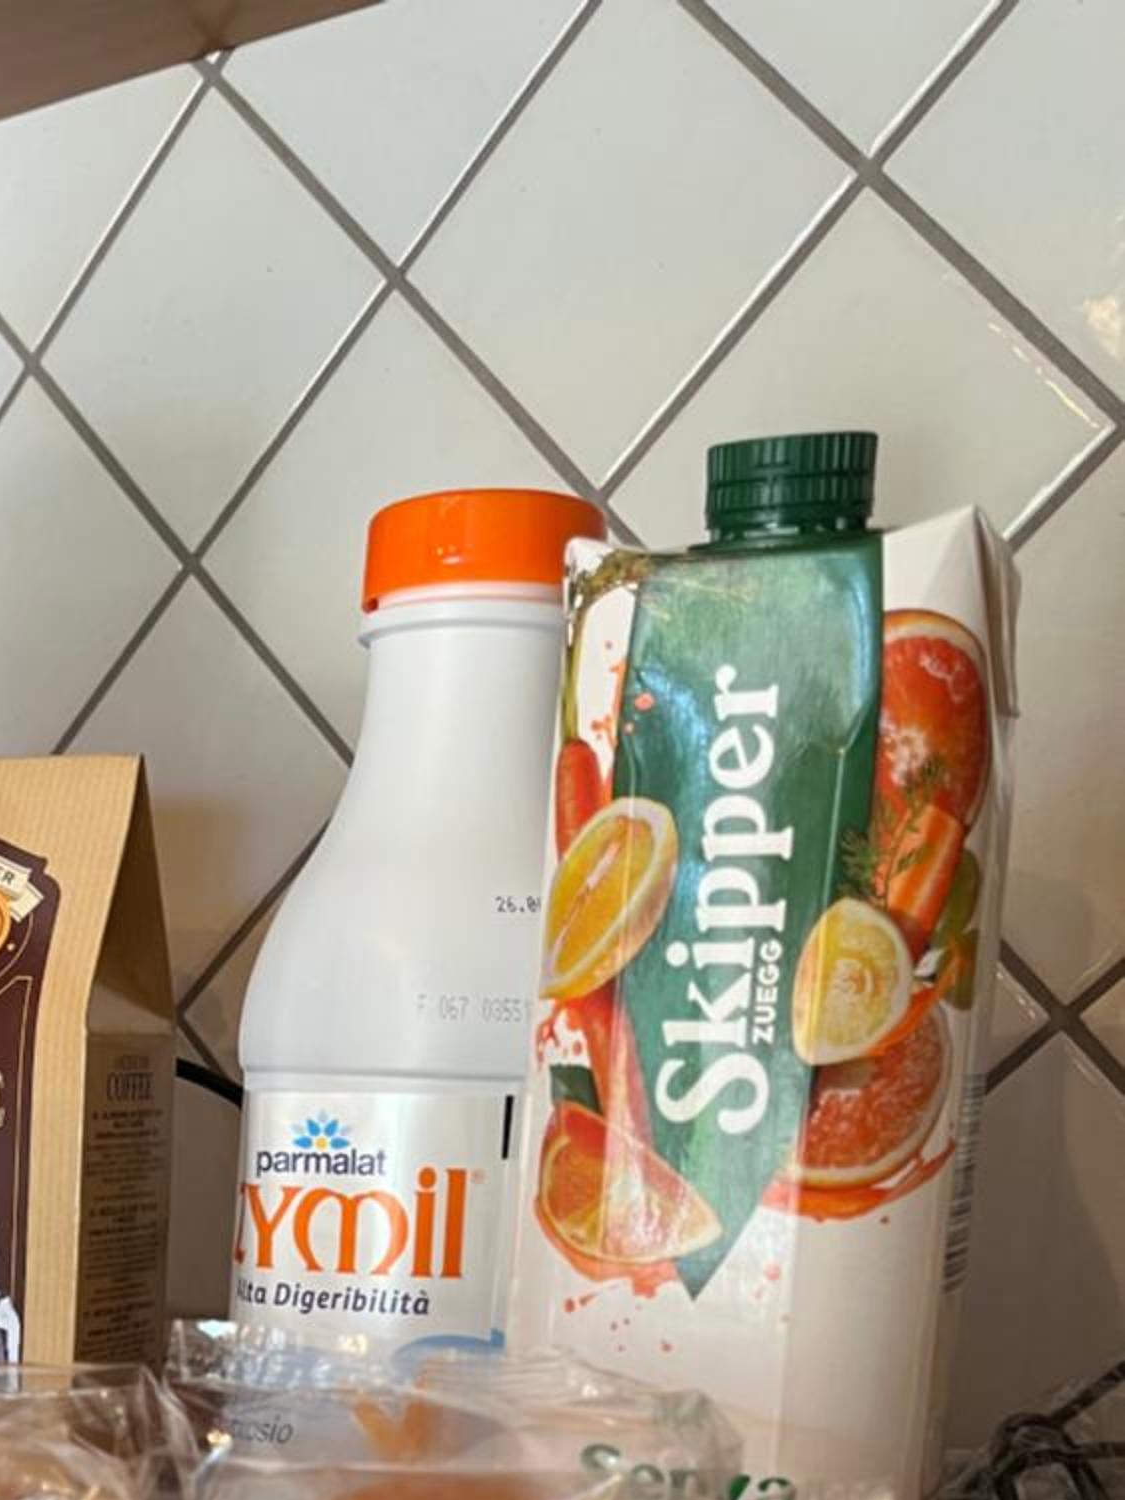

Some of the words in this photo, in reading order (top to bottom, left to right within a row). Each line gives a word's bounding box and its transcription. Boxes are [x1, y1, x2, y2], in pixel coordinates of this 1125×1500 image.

[654, 664, 794, 1135] Skipper
[751, 939, 784, 1045] ZUEGG
[256, 1149, 388, 1177] parmalat
[274, 1282, 431, 1315] Digeribilità
